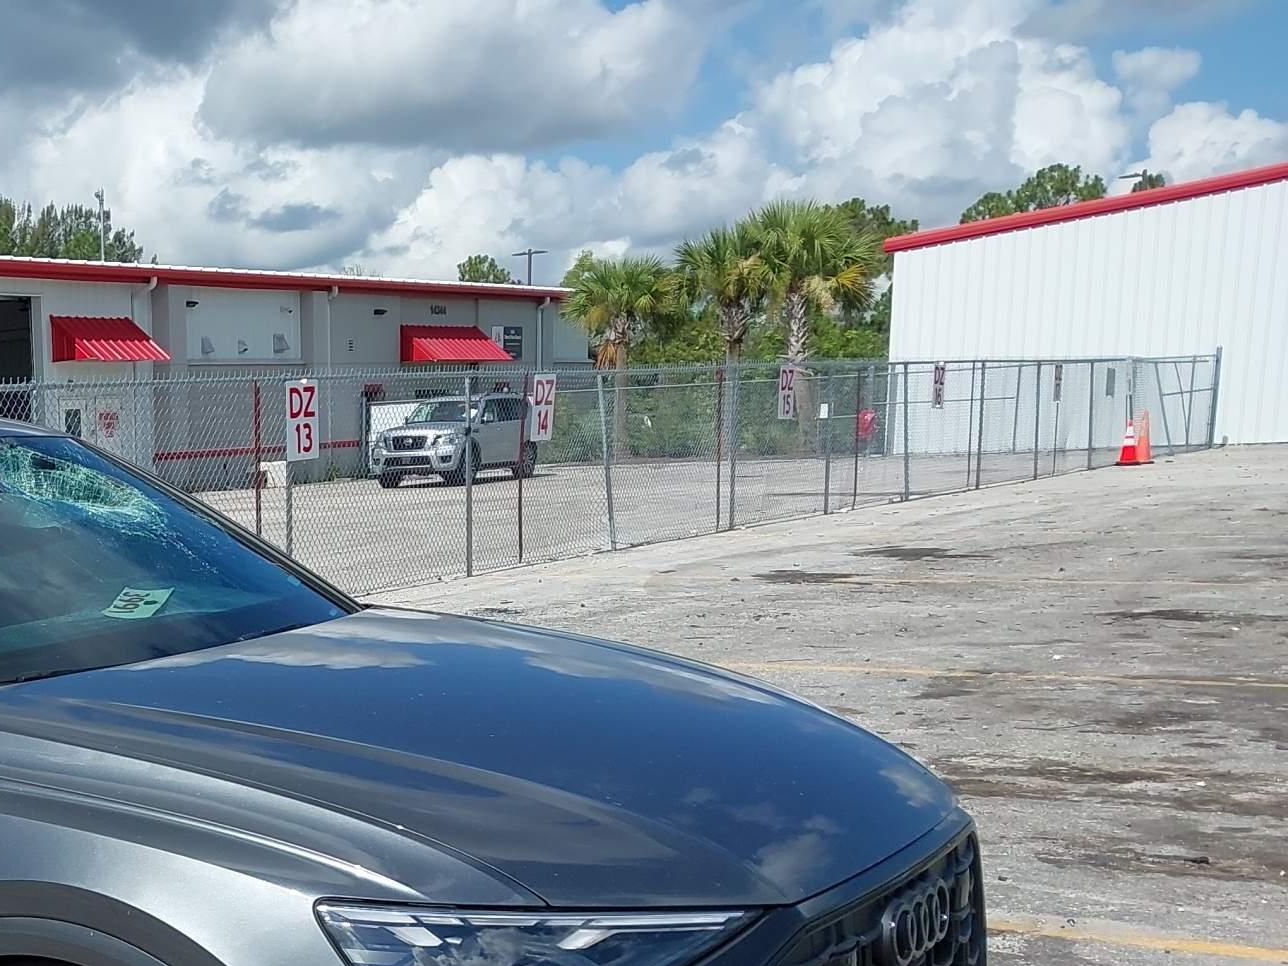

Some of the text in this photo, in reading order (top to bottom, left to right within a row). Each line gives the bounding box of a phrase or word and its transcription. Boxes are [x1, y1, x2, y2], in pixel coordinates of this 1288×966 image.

[782, 370, 794, 391] DZ
[934, 366, 945, 385] DZ
[289, 386, 316, 419] DZ
[535, 380, 555, 406] DZ
[783, 394, 791, 416] 15
[537, 409, 549, 435] 14
[295, 422, 313, 454] 13
